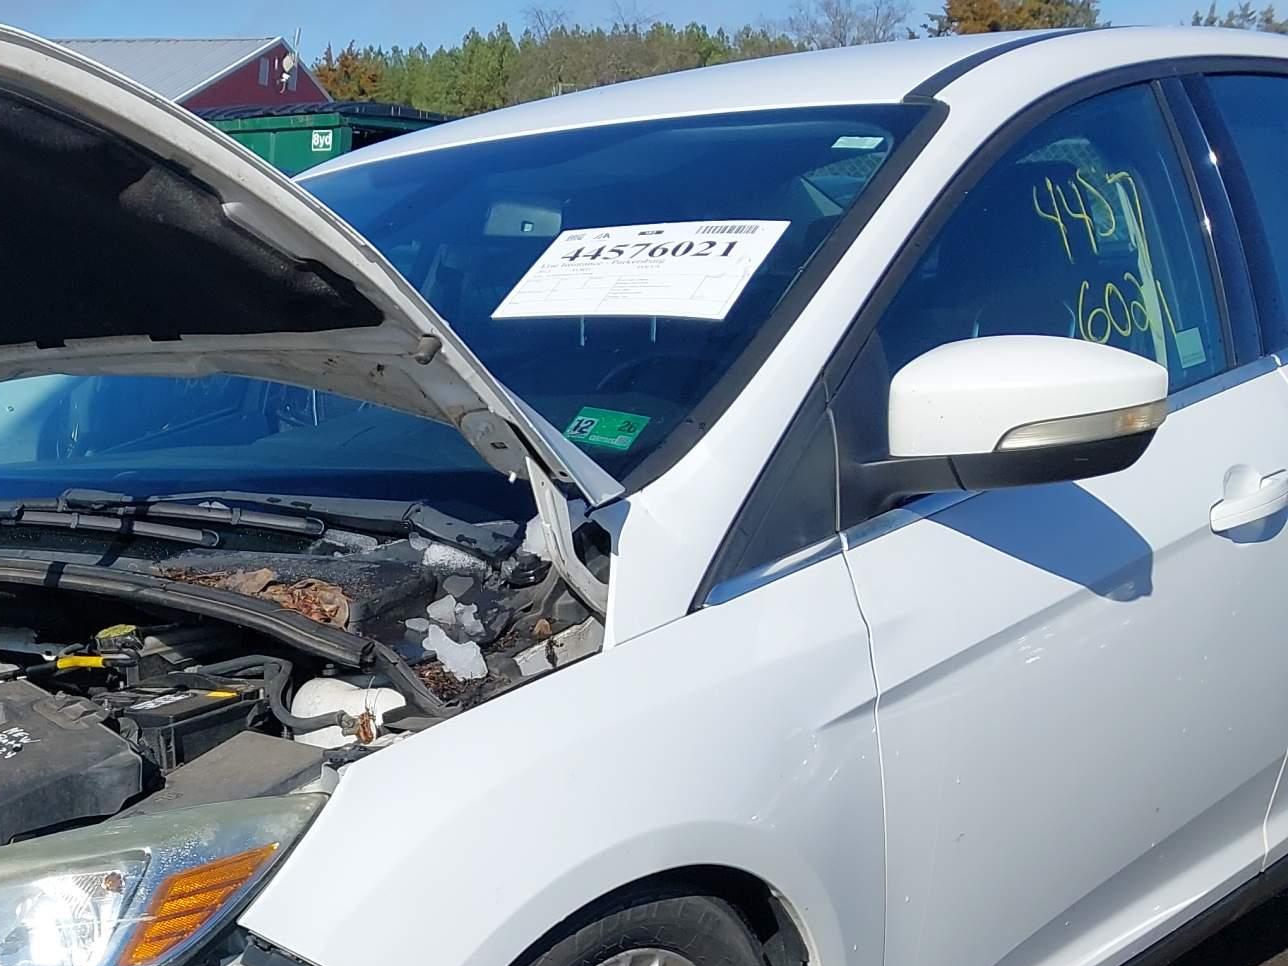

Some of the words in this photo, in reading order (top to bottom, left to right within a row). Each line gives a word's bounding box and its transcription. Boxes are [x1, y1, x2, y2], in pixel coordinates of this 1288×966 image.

[313, 133, 332, 148] 8yd
[561, 240, 738, 262] 44576021
[1078, 271, 1178, 344] 6021
[572, 419, 595, 434] 12
